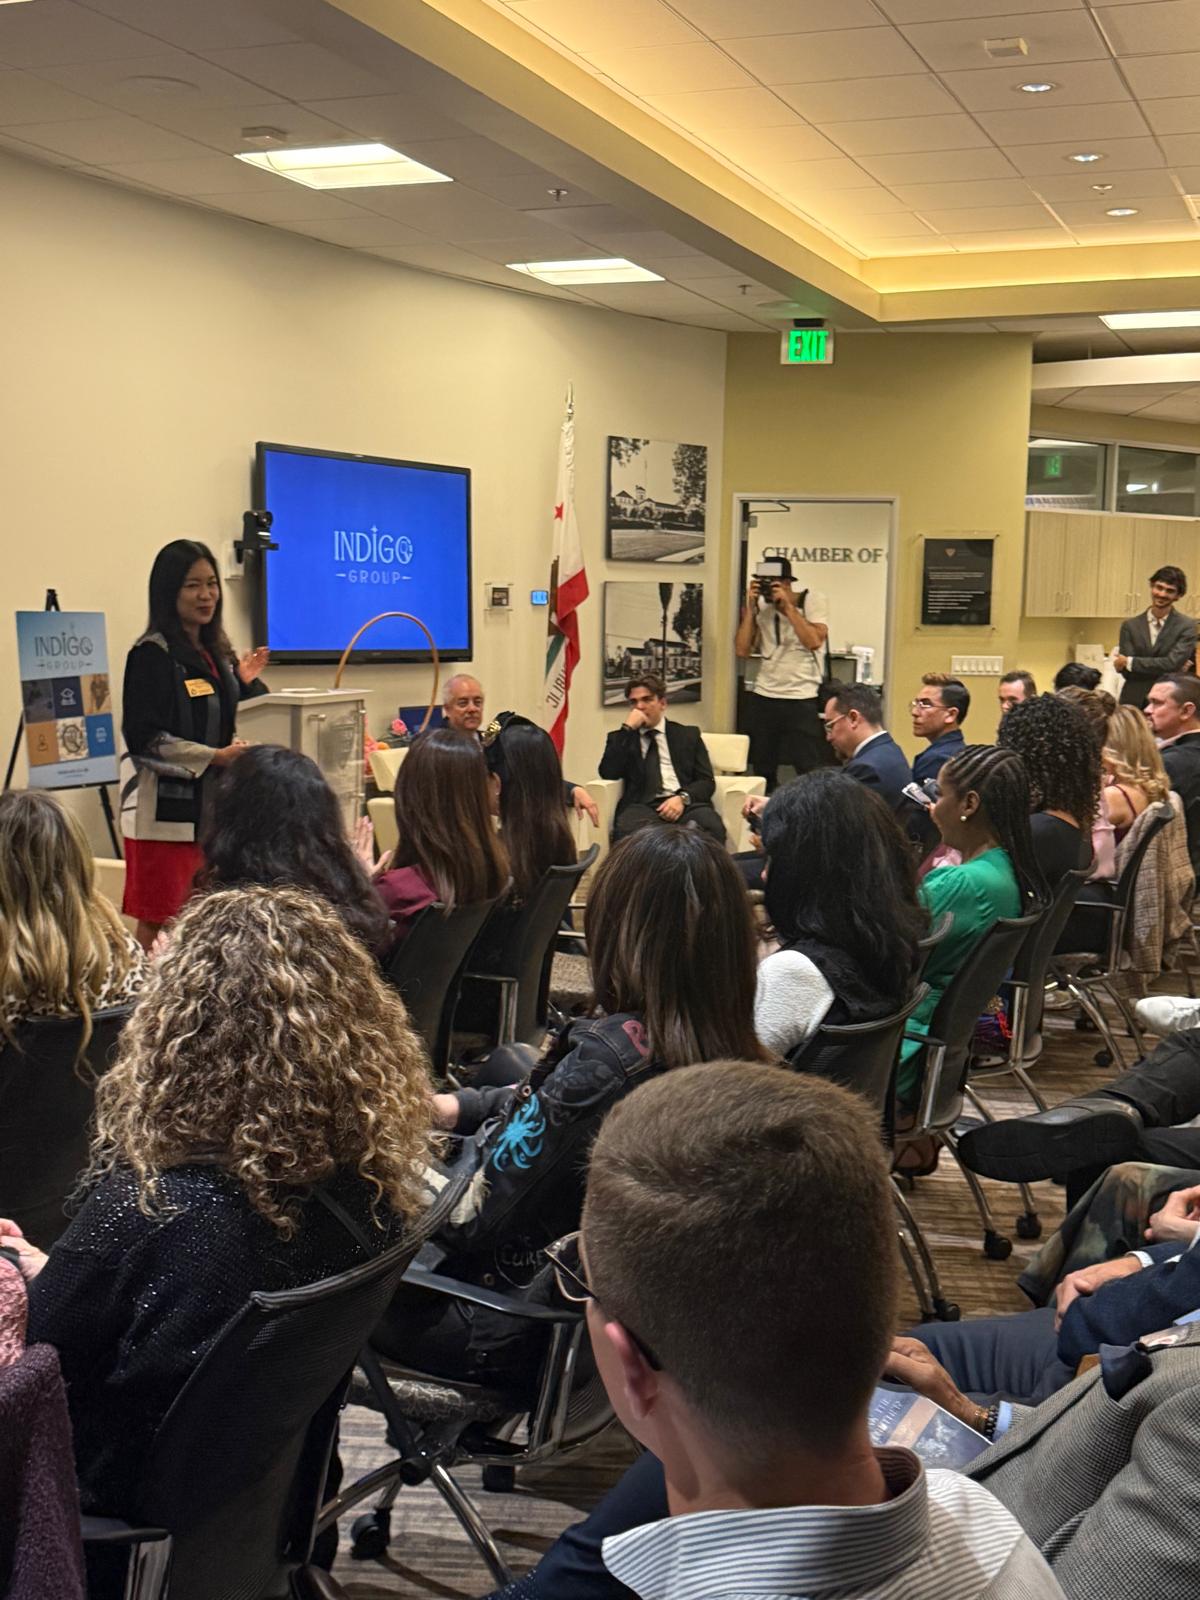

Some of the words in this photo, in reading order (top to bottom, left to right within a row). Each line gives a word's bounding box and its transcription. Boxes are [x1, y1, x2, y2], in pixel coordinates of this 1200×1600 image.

[789, 330, 829, 362] EXIT
[762, 546, 853, 563] CHAMBER
[858, 548, 883, 563] OF
[348, 569, 401, 585] GROUP
[46, 659, 85, 671] GROUP
